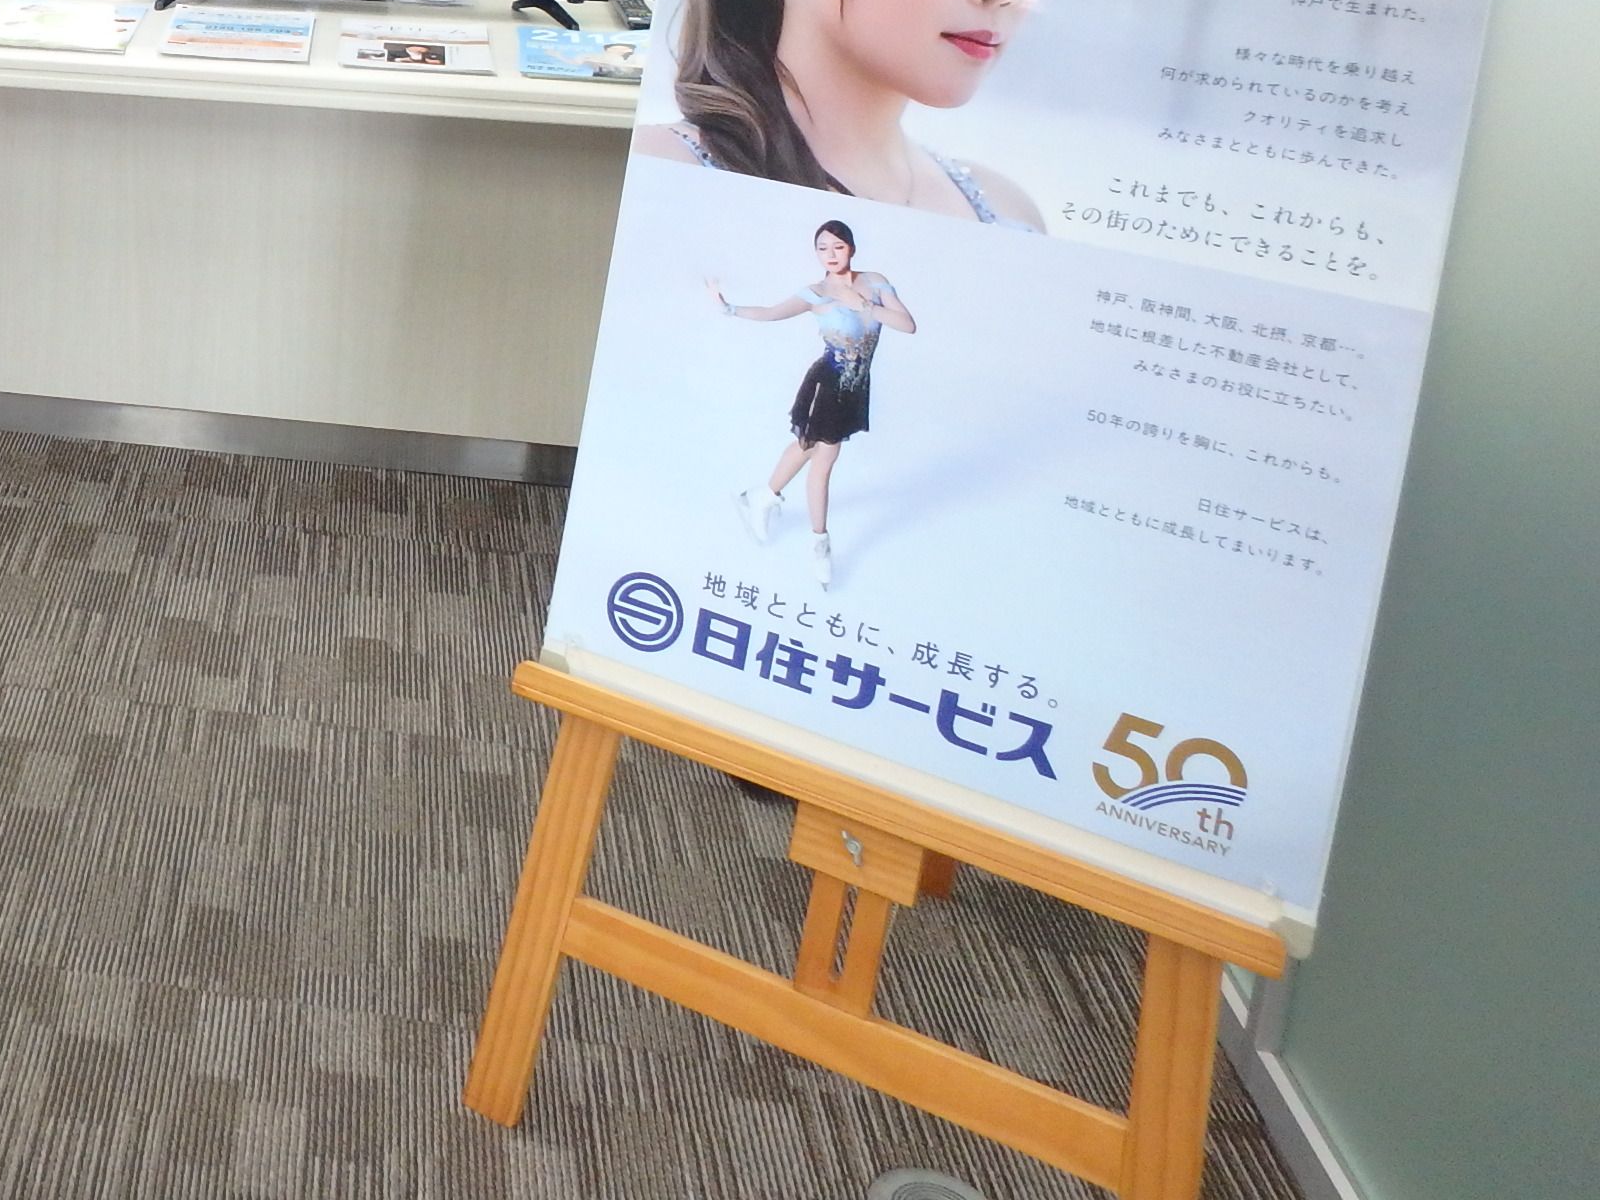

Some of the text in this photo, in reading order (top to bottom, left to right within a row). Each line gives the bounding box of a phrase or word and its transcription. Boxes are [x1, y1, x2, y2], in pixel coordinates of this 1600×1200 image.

[1160, 65, 1411, 117] 何が求められているのかを考え
[1234, 46, 1416, 86] 様々な時代を乗り越え
[1157, 126, 1399, 181] みなさまとともに歩んできた。
[1242, 109, 1404, 148] クオリティを追求し
[1061, 201, 1379, 281] その街のためにできることを。
[1107, 175, 1386, 246] これまでも、これからも、
[1089, 318, 1359, 391] 地域に根差した不動産会社として、
[1132, 358, 1354, 423] みなさまのお役に立ちたい。
[1086, 408, 1341, 484] 50年の誇りを胸に、これからも。
[1063, 494, 1324, 577] 地域とともに成長してまいります。
[1197, 497, 1329, 545] 日住サービスは、
[702, 571, 1059, 710] 地域とともに、成長する。
[691, 606, 1058, 781] 日住サービス
[1091, 711, 1249, 841] 50 th
[1094, 800, 1232, 857] ANNIVERSARY
